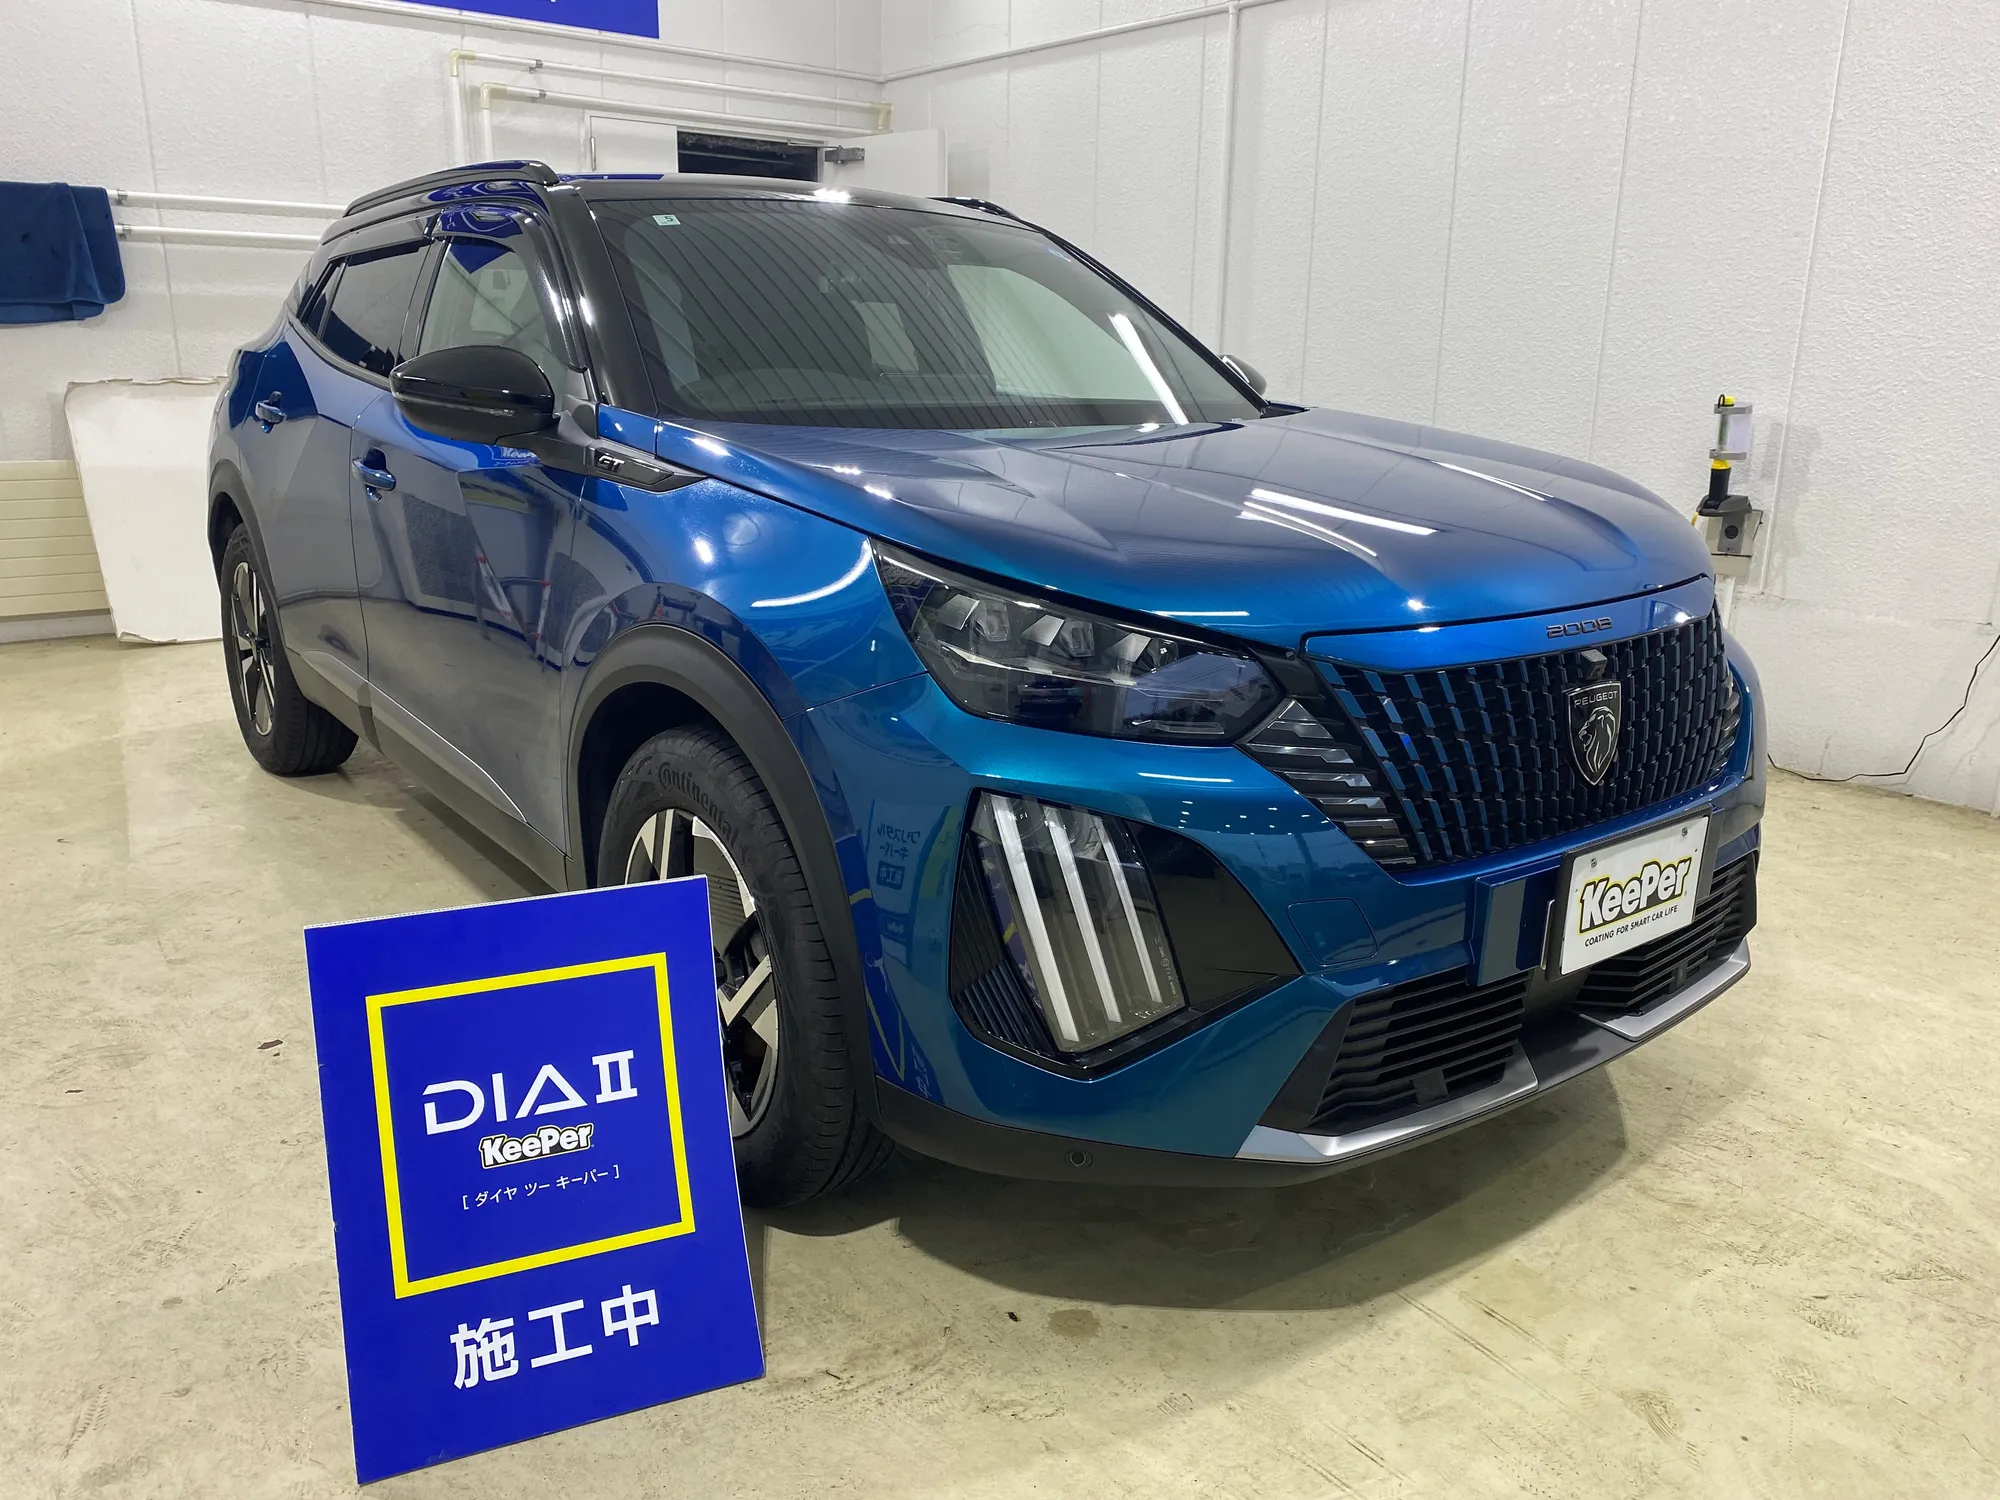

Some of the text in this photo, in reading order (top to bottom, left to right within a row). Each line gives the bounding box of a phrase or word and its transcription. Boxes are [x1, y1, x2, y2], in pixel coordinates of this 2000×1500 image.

[598, 453, 625, 473] GT
[1546, 616, 1612, 639] 2008
[1574, 690, 1618, 708] PEUGEOT
[658, 761, 740, 848] Continental
[1579, 856, 1692, 934] KeePer
[1584, 904, 1678, 947] COATING FOR SMART CAR LIFE
[479, 1122, 594, 1170] KeePer
[474, 1186, 518, 1207] ダイヤ
[524, 1182, 550, 1197] ツー
[555, 1169, 609, 1190] キーパー
[450, 1284, 660, 1390] 施工中
